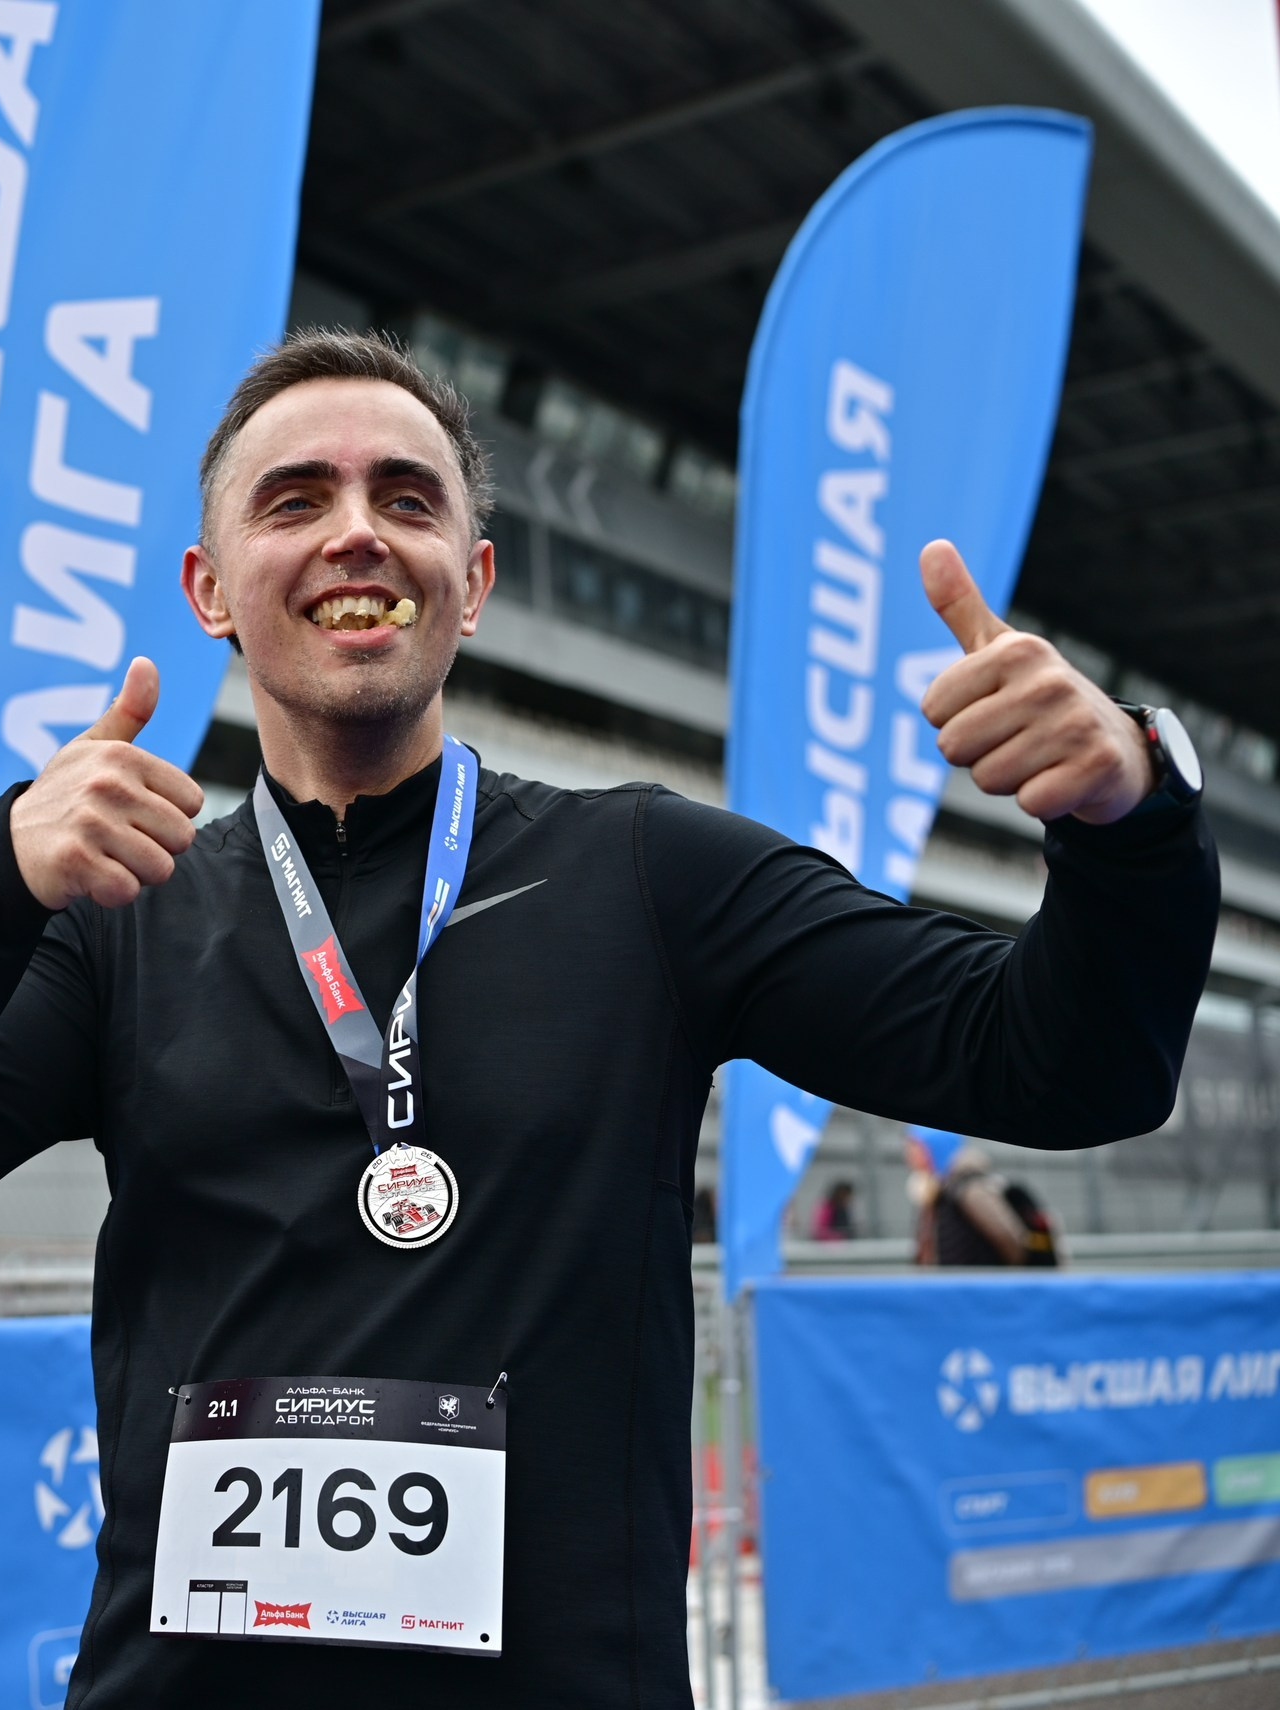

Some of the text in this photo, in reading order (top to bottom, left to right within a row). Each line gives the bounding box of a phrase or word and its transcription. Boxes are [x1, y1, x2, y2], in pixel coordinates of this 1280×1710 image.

[806, 358, 894, 878] ЫСШАЯ
[449, 763, 466, 837] ВЫСШАЯ ЛИГА
[281, 855, 313, 919] МАГНИТ
[314, 951, 346, 1010] Альфа Банк
[372, 1158, 383, 1170] 20
[377, 1176, 434, 1193] СИРИУС
[286, 1387, 366, 1396] АЛЬФА-БАНК
[1009, 1356, 1203, 1415] ВЫСШАЯ
[207, 1399, 239, 1418] 21.1
[275, 1398, 377, 1414] СИРИУС
[275, 1415, 375, 1426] АВТОДРОМ
[212, 1466, 449, 1556] 2169
[261, 1609, 305, 1620] Альфа Банк
[341, 1618, 367, 1627] ЛИГА
[342, 1610, 386, 1620] ВЫСШАЯ
[419, 1619, 465, 1631] МАГНИТ
